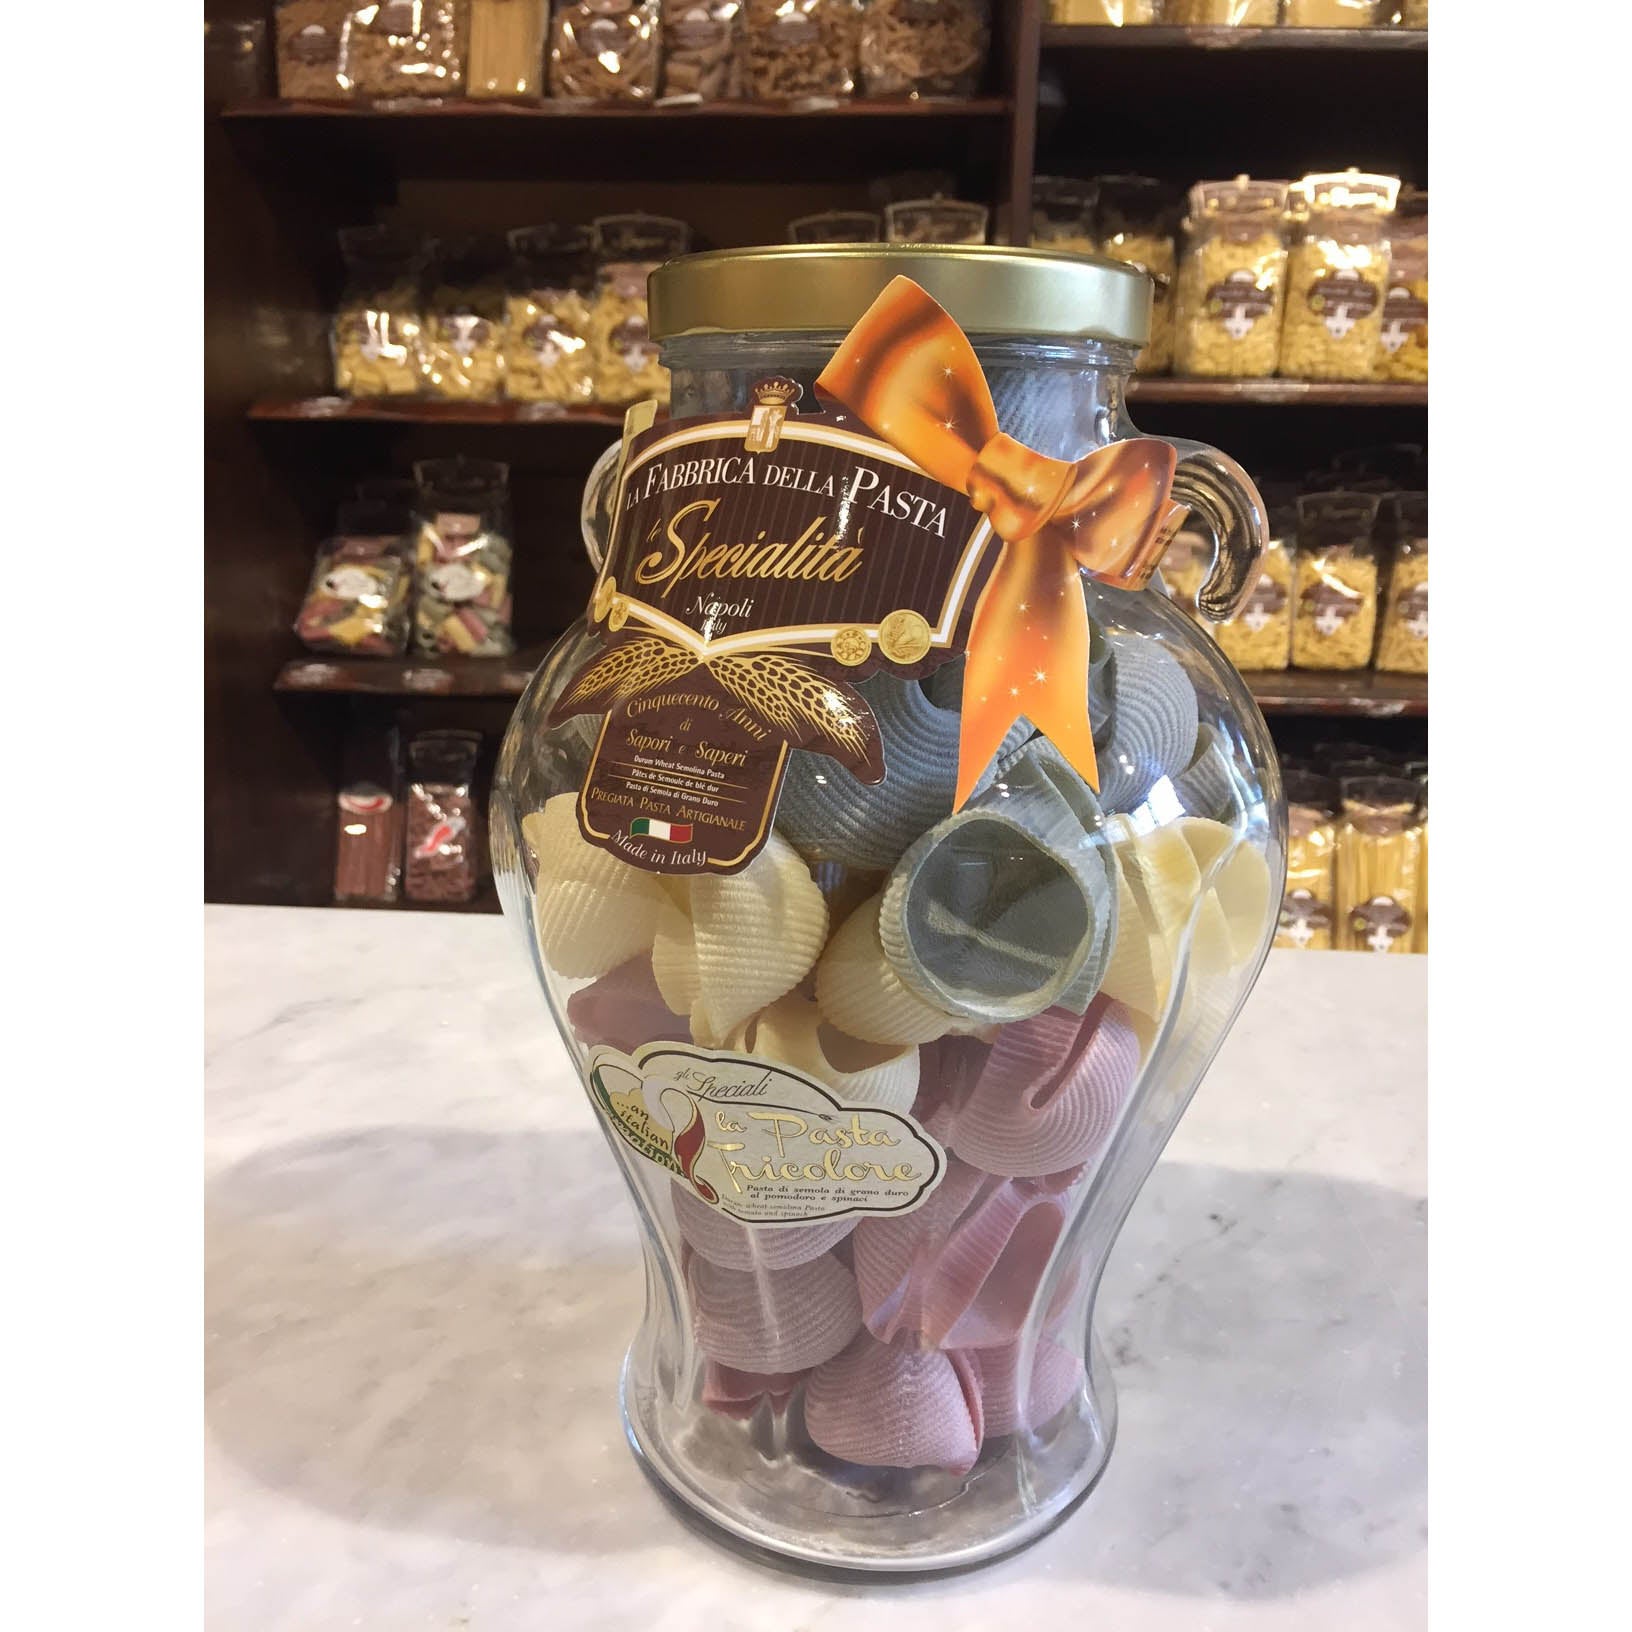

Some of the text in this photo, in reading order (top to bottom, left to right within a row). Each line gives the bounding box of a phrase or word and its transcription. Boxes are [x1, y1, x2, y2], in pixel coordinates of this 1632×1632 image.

[627, 457, 947, 538] LA FABBRICA DELLA PASTA
[685, 592, 754, 619] Napoli
[626, 693, 771, 742] Cinquecento Anni
[679, 717, 692, 731] di
[626, 728, 748, 767] Sapori e Saperi
[632, 768, 648, 778] Pâtes
[648, 771, 657, 780] de
[657, 773, 685, 785] Semoule
[685, 779, 694, 788] de
[707, 784, 720, 793] dur
[634, 754, 725, 779] Durum Wheat Semolina Pasta
[591, 787, 747, 831] PREGIATA PASTA ARTIGIANALE
[626, 781, 719, 807] Pasta di Semola di Grano Duro
[610, 829, 707, 867] Made in Italy
[673, 1068, 773, 1102] gli Speciali
[714, 1111, 901, 1158] la Pasta
[707, 1139, 922, 1194] Tricolore
[746, 1184, 910, 1197] Pasta di semola di grano duro
[750, 1192, 761, 1200] al
[764, 1192, 816, 1202] pomodoro
[831, 1195, 869, 1204] spinaci
